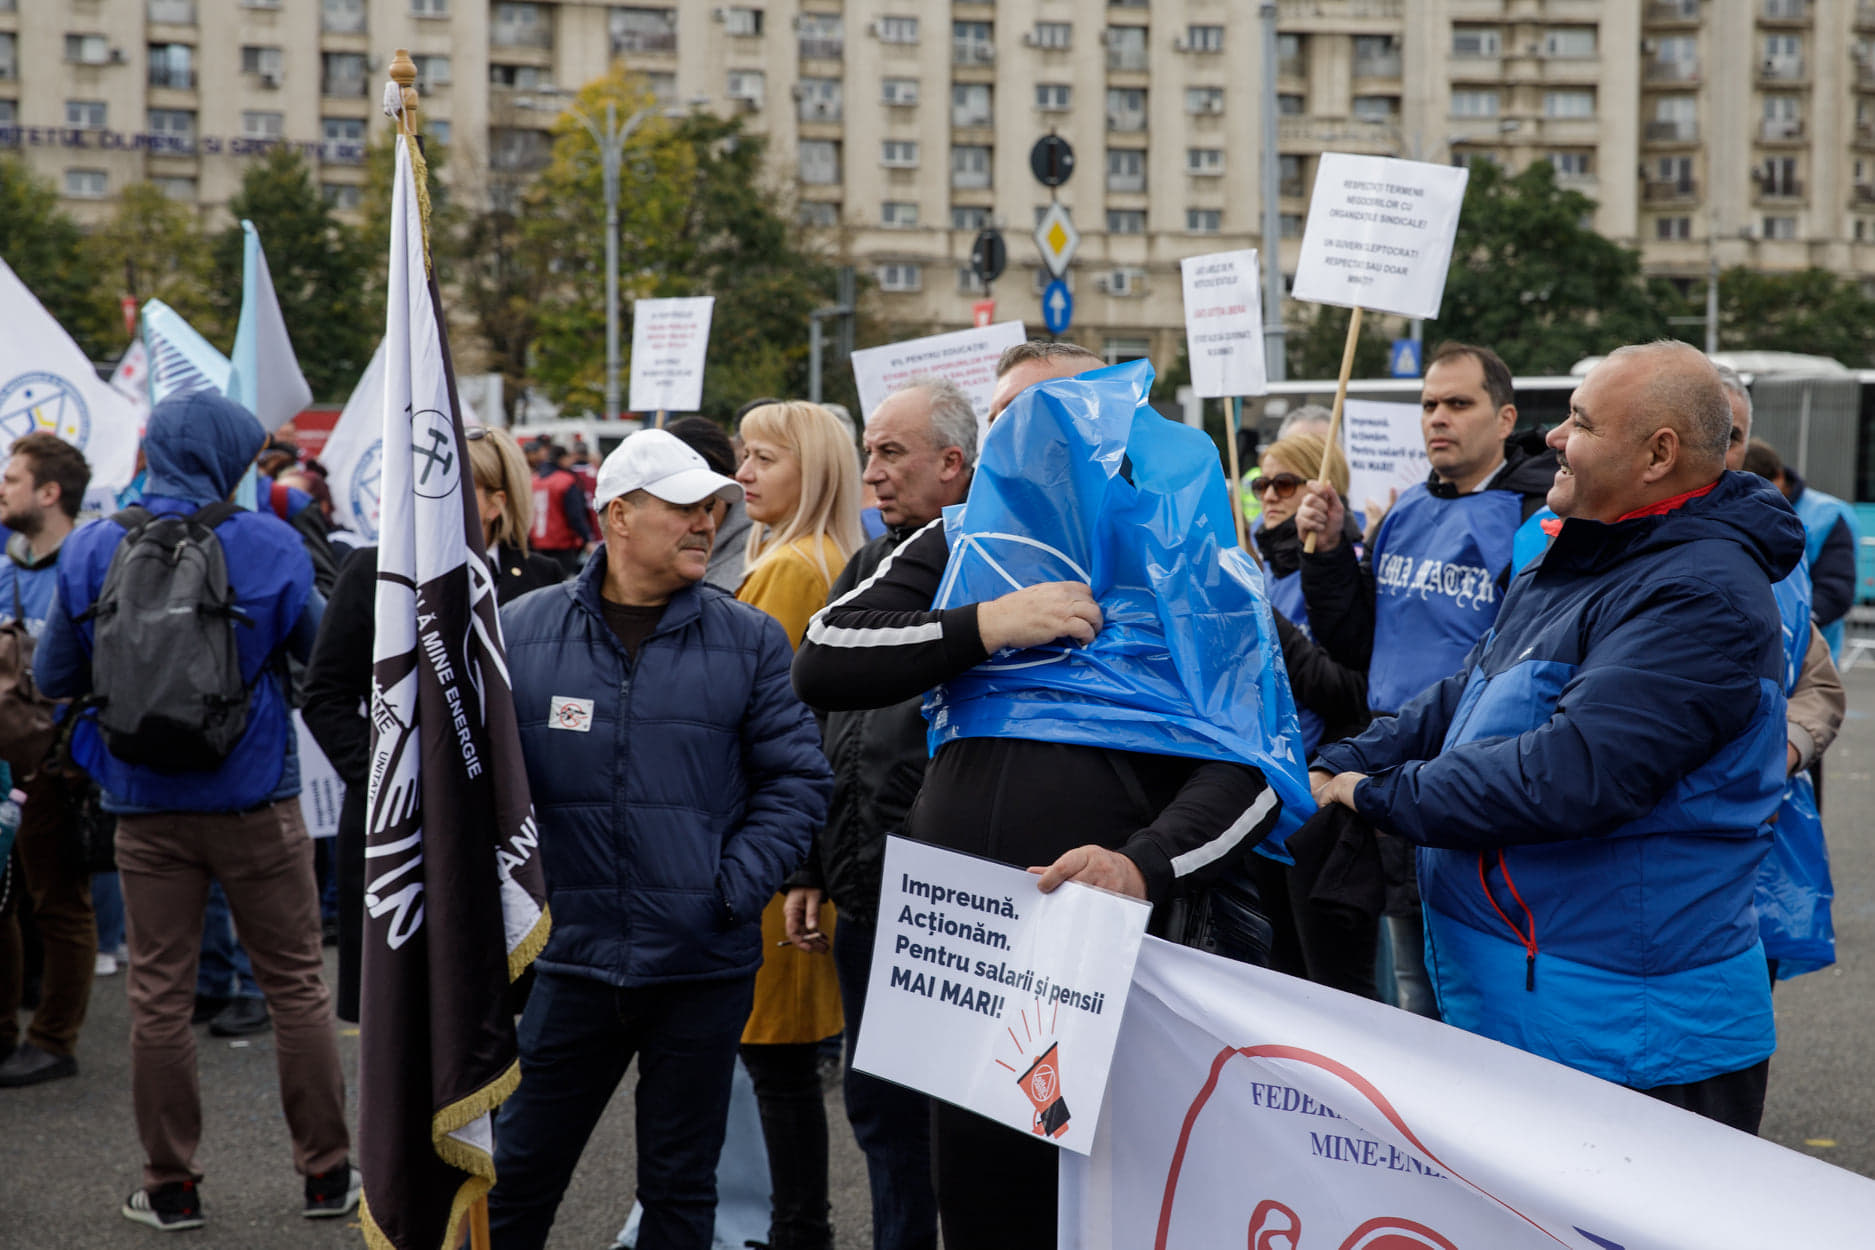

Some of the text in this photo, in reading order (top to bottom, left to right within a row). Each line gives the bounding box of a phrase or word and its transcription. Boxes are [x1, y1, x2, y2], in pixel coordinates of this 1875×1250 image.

[421, 630, 455, 685] MINE
[445, 686, 483, 780] ENERGIE
[897, 904, 1012, 952] Acționăm.
[890, 965, 1006, 1020] MAI MARI!
[895, 933, 1106, 1016] Pentru salarii și pensii
